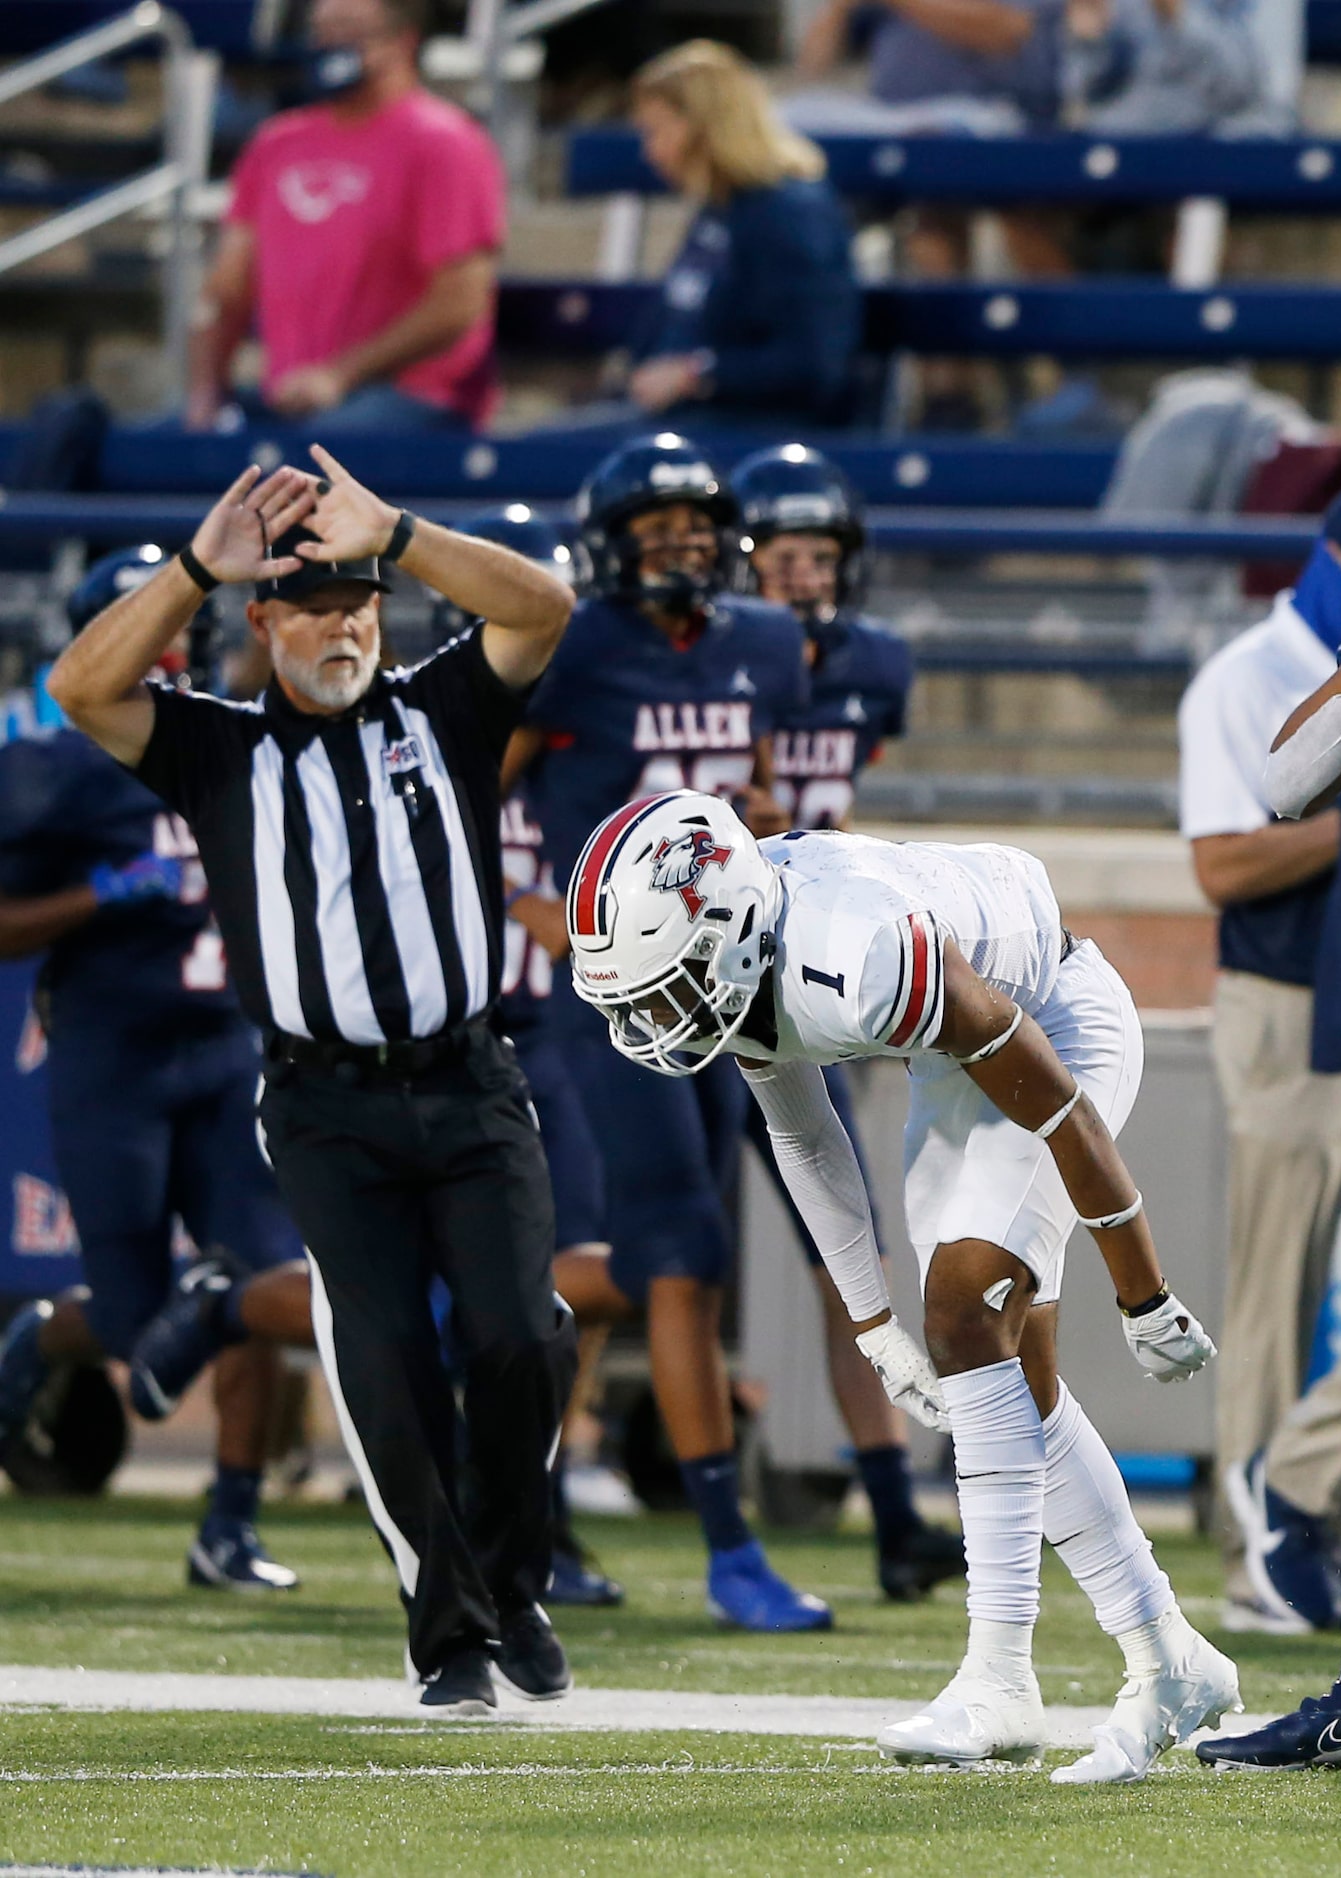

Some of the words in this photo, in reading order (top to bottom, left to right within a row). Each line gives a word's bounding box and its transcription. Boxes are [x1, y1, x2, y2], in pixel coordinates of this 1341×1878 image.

[633, 703, 751, 750] ALLEN
[773, 729, 857, 777] LLEN
[802, 963, 845, 999] 1
